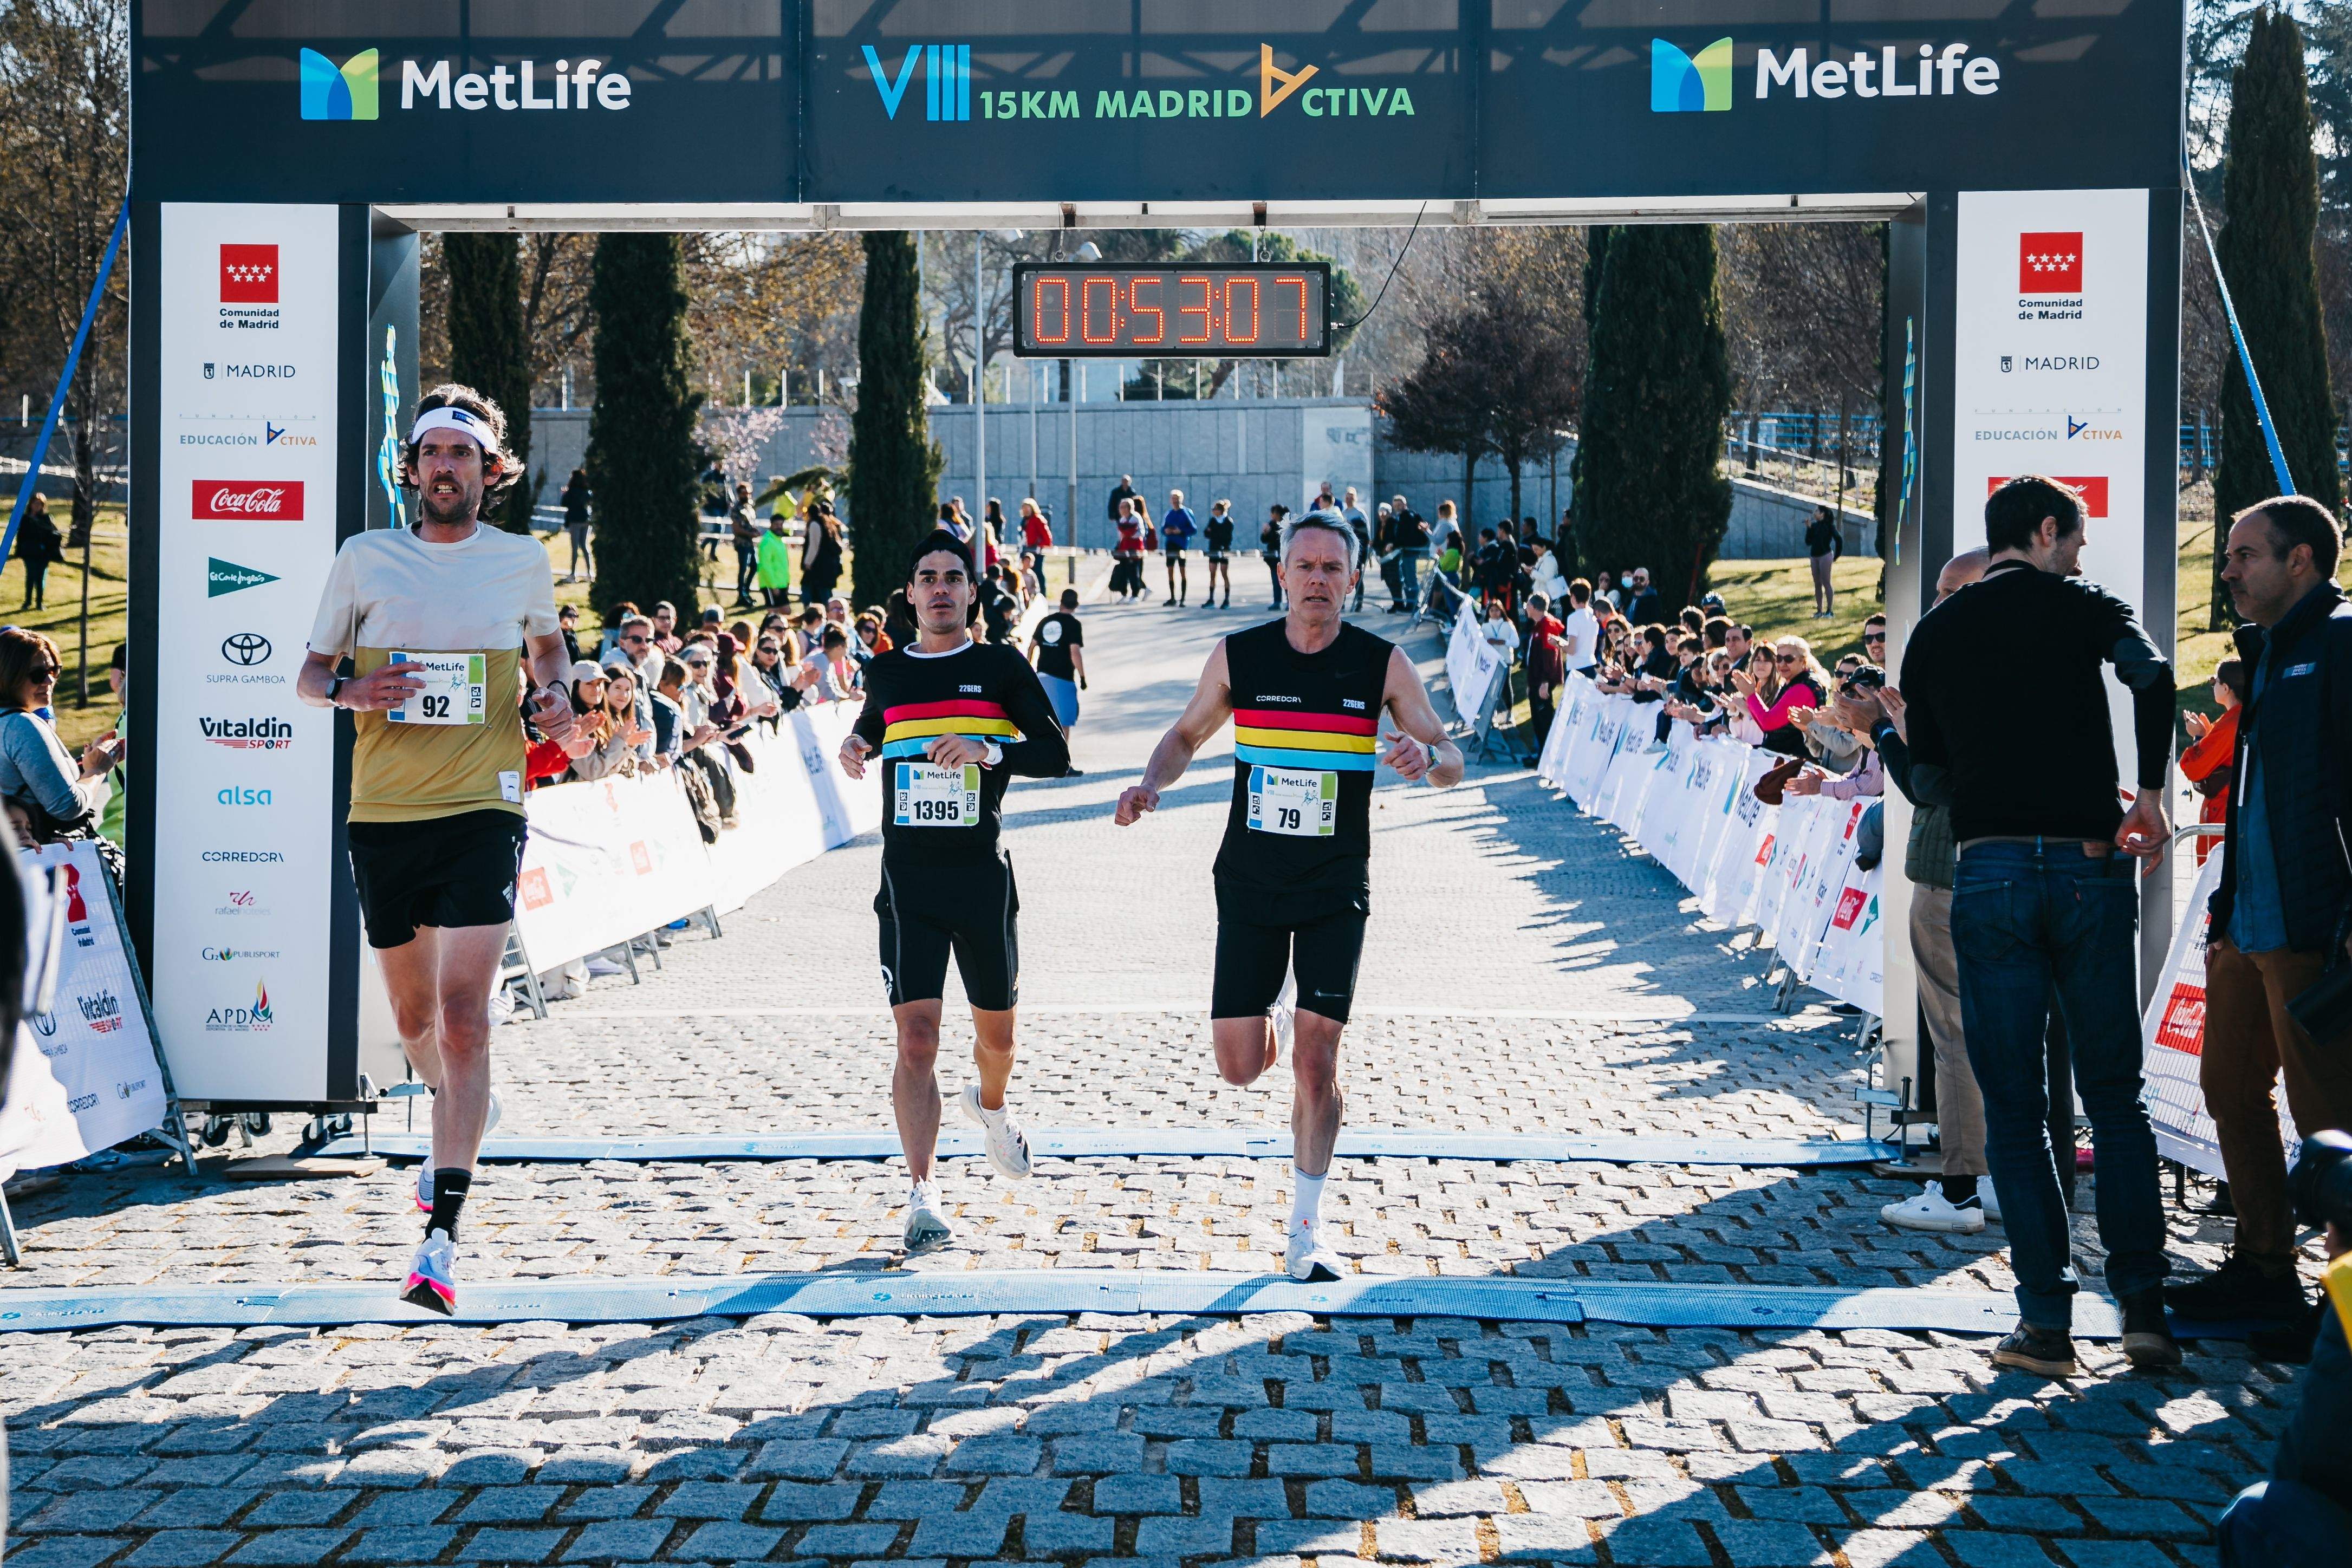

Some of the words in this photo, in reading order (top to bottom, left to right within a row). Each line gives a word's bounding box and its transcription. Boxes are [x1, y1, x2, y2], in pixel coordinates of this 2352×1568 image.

[1756, 43, 2000, 99] MetLife
[401, 59, 631, 110] MetLife
[861, 45, 970, 121] VIII
[980, 90, 1080, 119] 15KM
[1095, 89, 1253, 119] MADRID
[2018, 299, 2083, 308] Comunidad
[219, 308, 280, 317] Comunidad
[2018, 311, 2033, 320] de
[2038, 310, 2082, 320] Madrid
[219, 320, 234, 328] de
[238, 320, 279, 329] Madrid
[2025, 356, 2100, 370] MADRID
[227, 365, 296, 378] MADRID
[180, 433, 257, 445] EDUCACIÓN
[1975, 427, 2058, 440] EDUCACIÓN
[210, 487, 285, 512] Coca-Cola
[426, 663, 465, 672] MetLife
[206, 675, 238, 684] SUPRA
[241, 675, 286, 684] GAMBOA
[959, 685, 982, 693] 226ERS
[422, 695, 450, 718] 92
[1343, 699, 1365, 710] 226ERS
[199, 717, 292, 738] Vitaldin
[249, 740, 292, 750] SPORT
[1281, 778, 1317, 788] MetLife
[218, 786, 271, 805] alsa
[913, 801, 959, 820] 1395
[1278, 808, 1300, 829] 79
[206, 1009, 273, 1024] APDM
